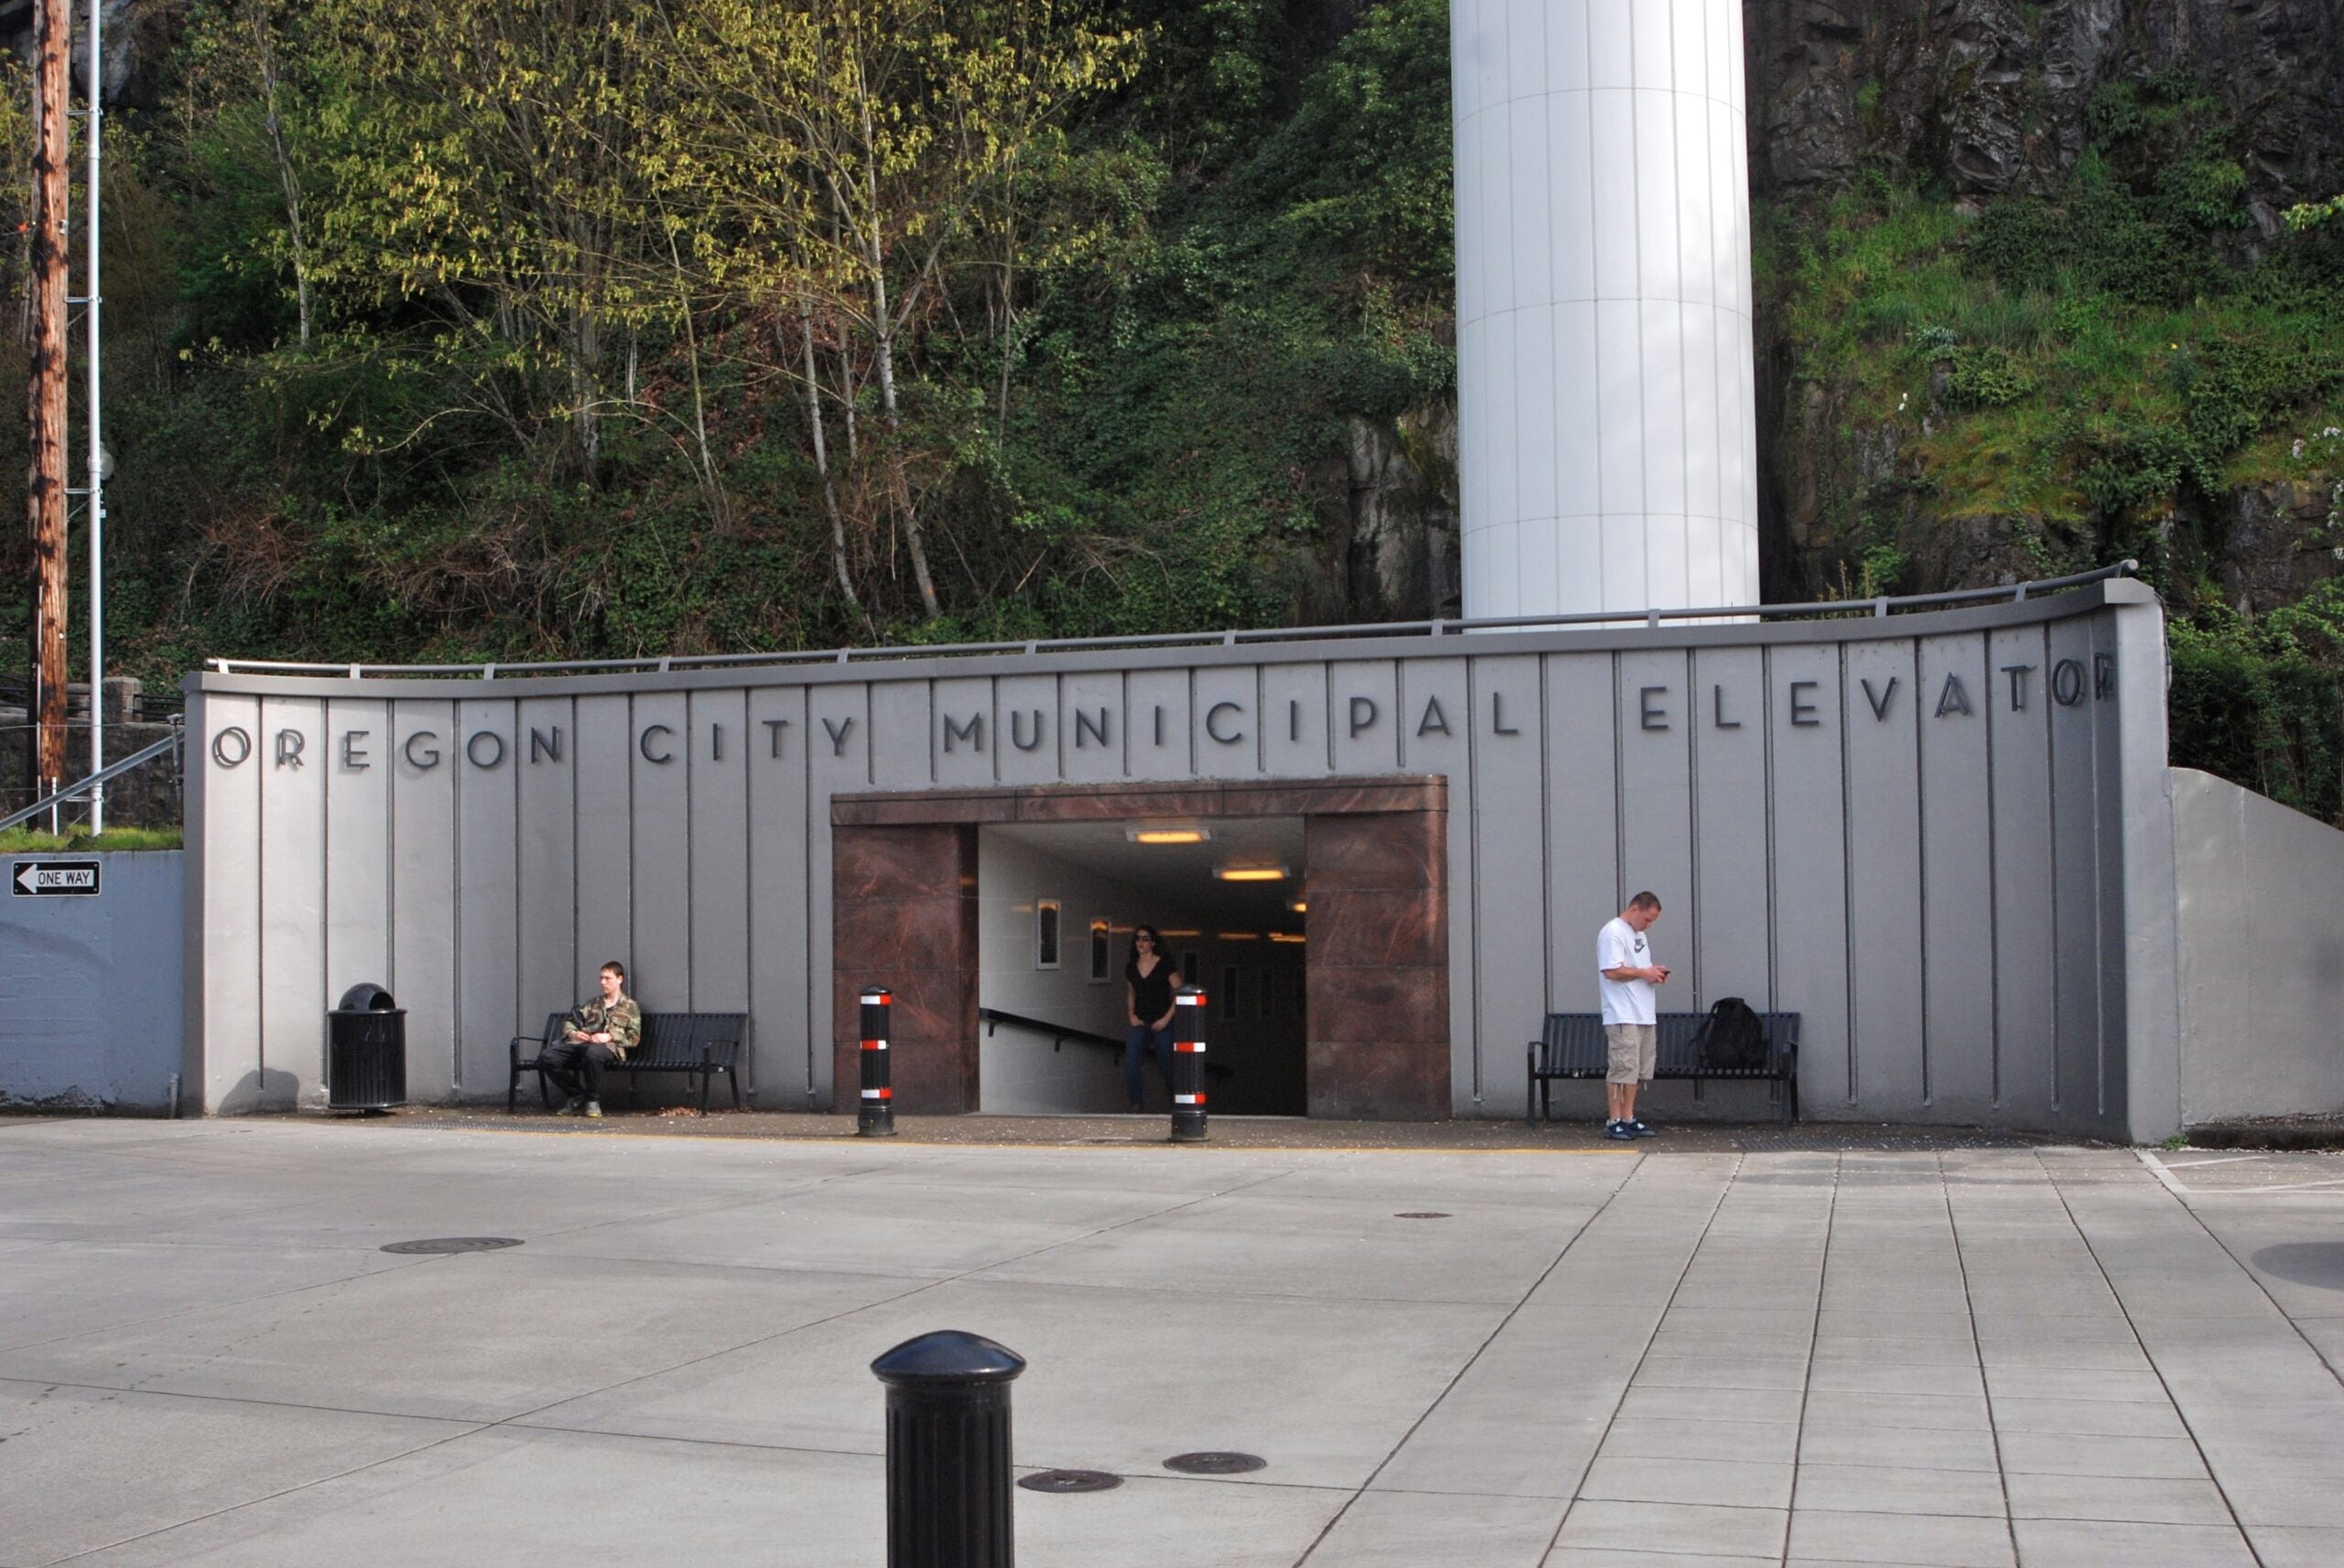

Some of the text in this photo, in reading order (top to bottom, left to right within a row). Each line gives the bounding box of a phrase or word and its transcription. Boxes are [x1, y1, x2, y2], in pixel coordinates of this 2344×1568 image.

[213, 652, 2116, 769] OREGON CITY MUNICIPAL ELEVATOR
[38, 871, 90, 885] ONE WAY
